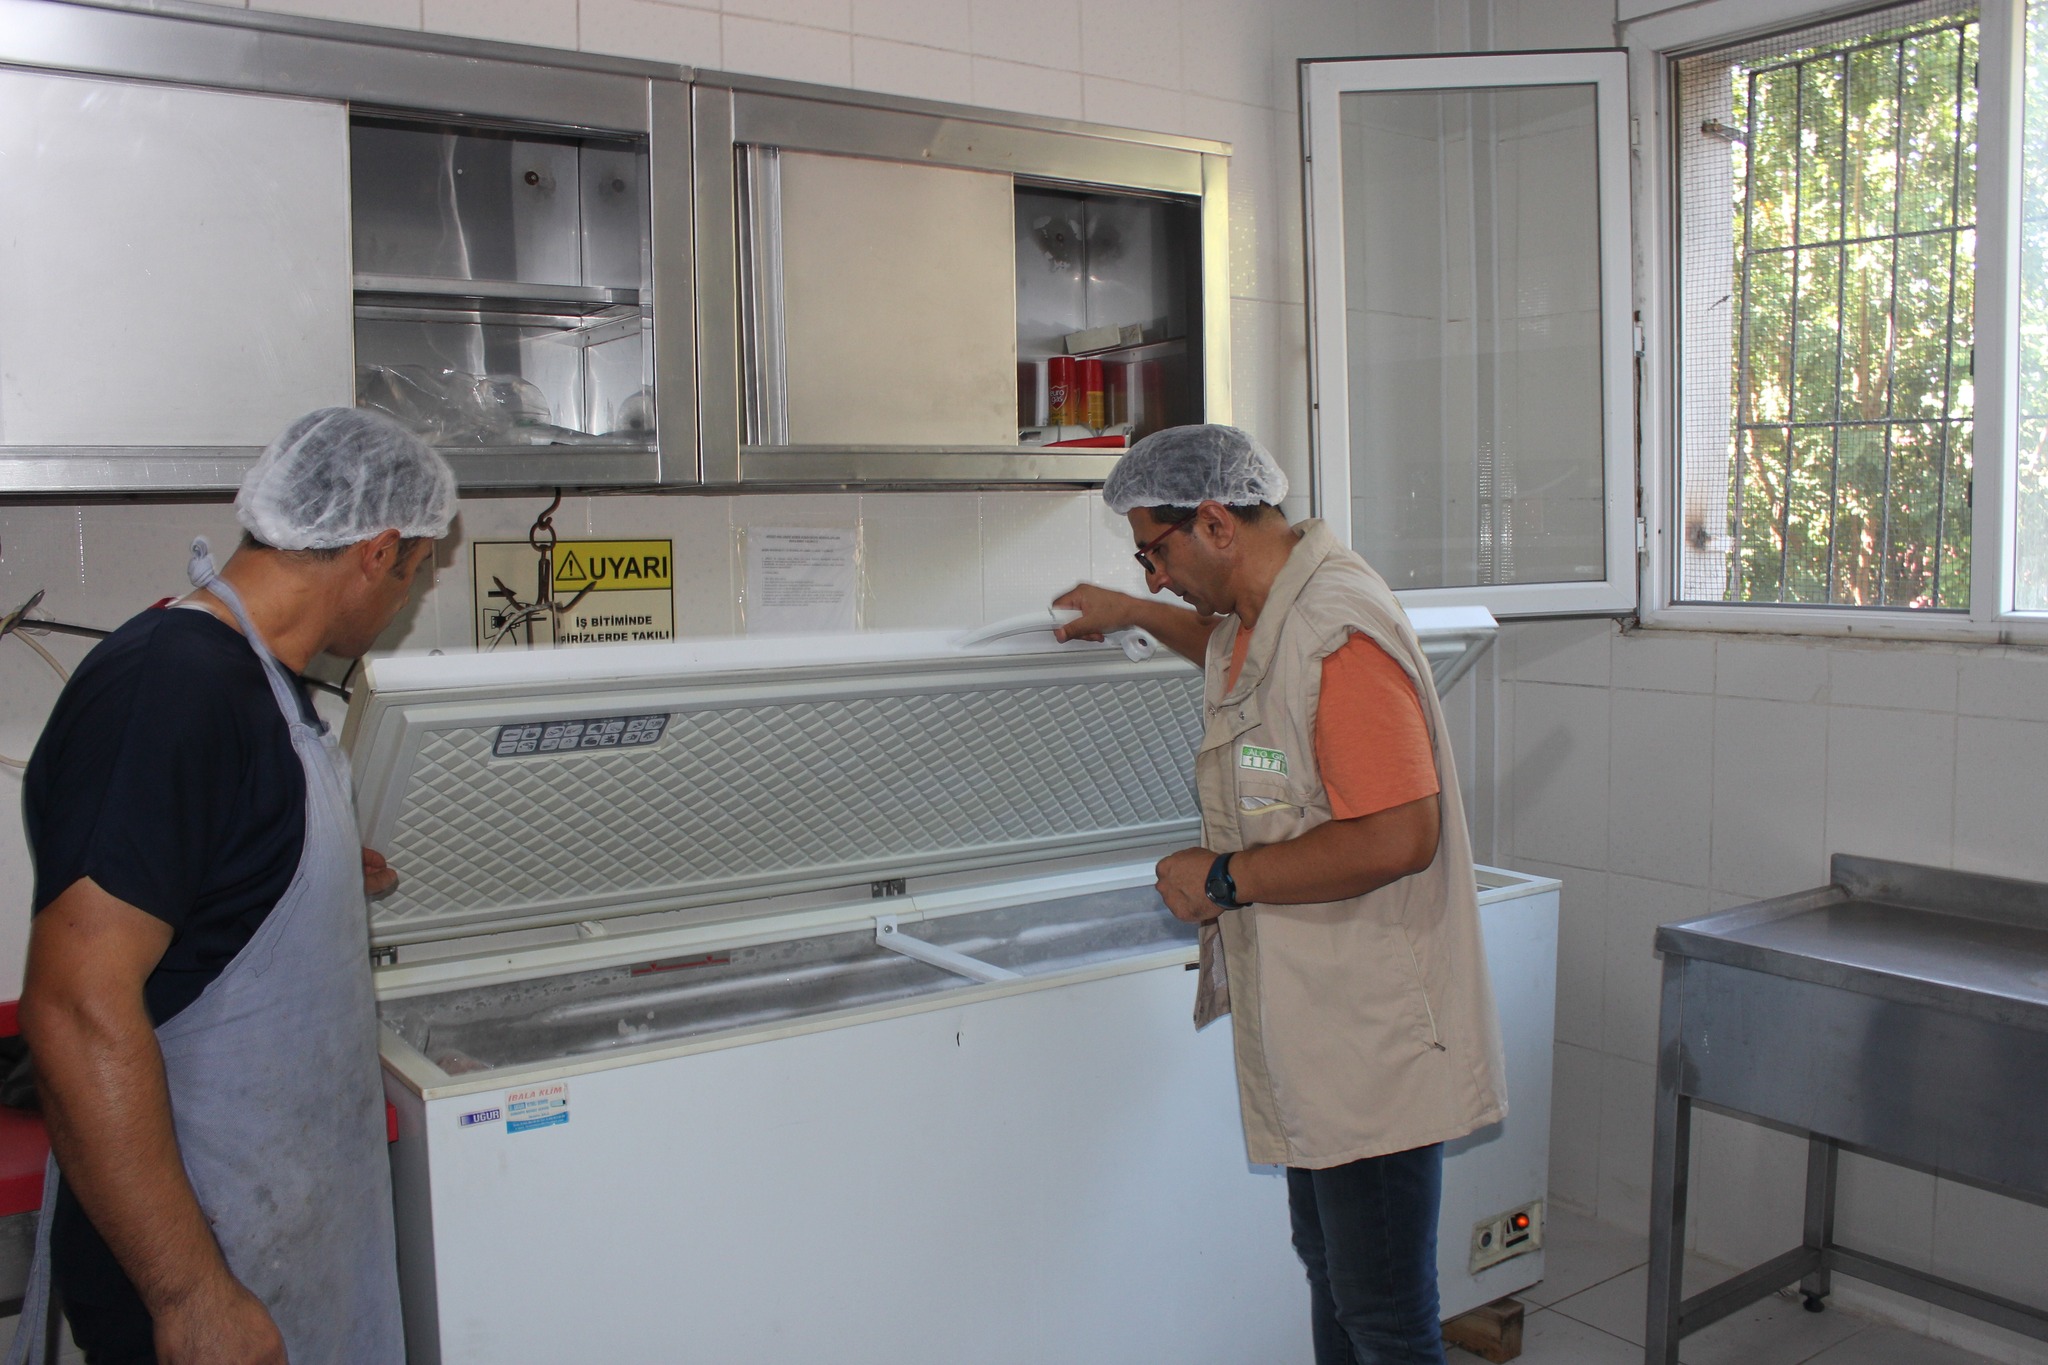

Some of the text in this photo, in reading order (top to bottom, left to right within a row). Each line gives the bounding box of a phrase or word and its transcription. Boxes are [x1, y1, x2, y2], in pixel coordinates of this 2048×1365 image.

[590, 556, 667, 580] UYARI
[576, 615, 652, 629] İŞ BİTİMİNDE
[632, 631, 669, 641] TAKILI
[473, 1110, 499, 1122] UGUR
